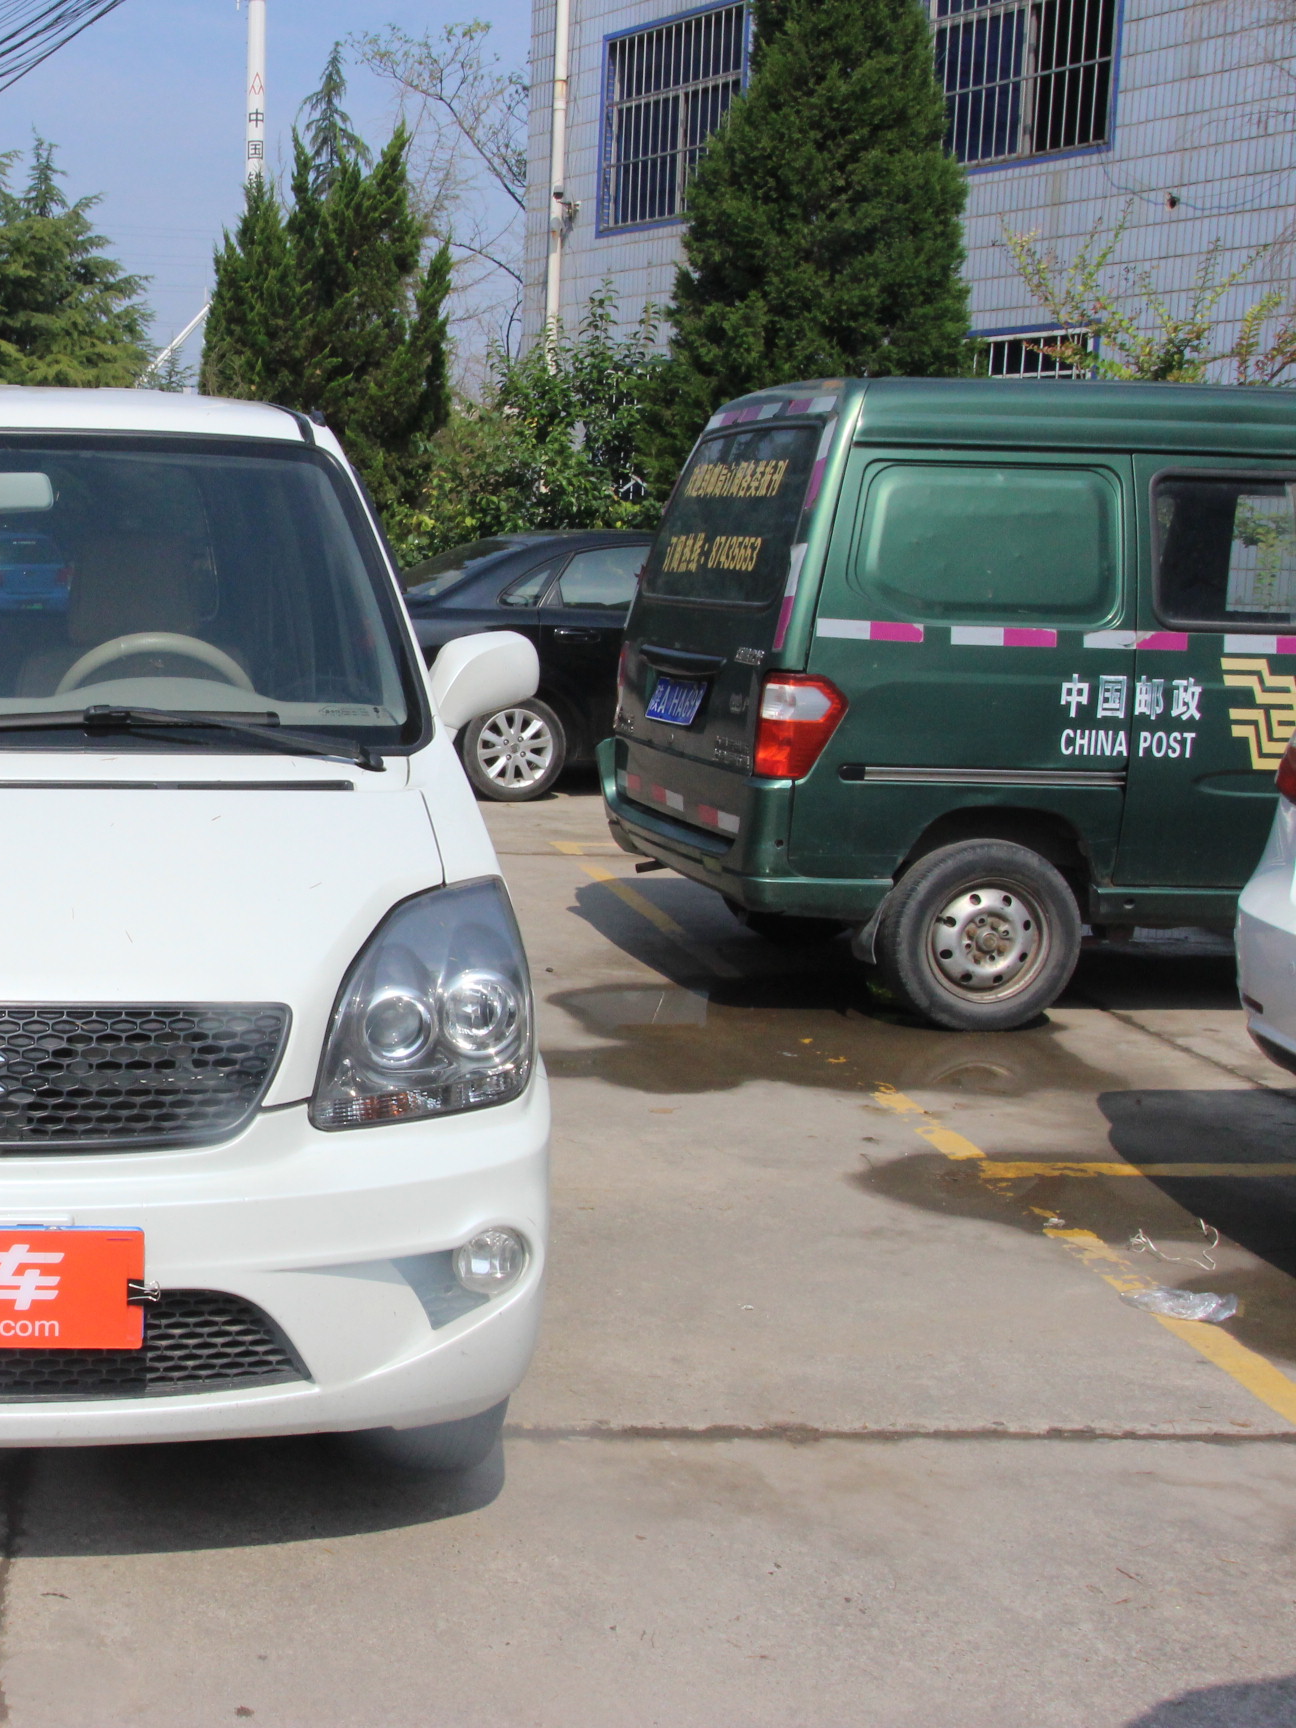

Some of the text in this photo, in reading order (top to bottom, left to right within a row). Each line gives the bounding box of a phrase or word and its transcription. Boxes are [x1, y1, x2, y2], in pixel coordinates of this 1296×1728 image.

[1060, 673, 1202, 721] 中国邮政
[1060, 728, 1196, 759] CHINA POST
